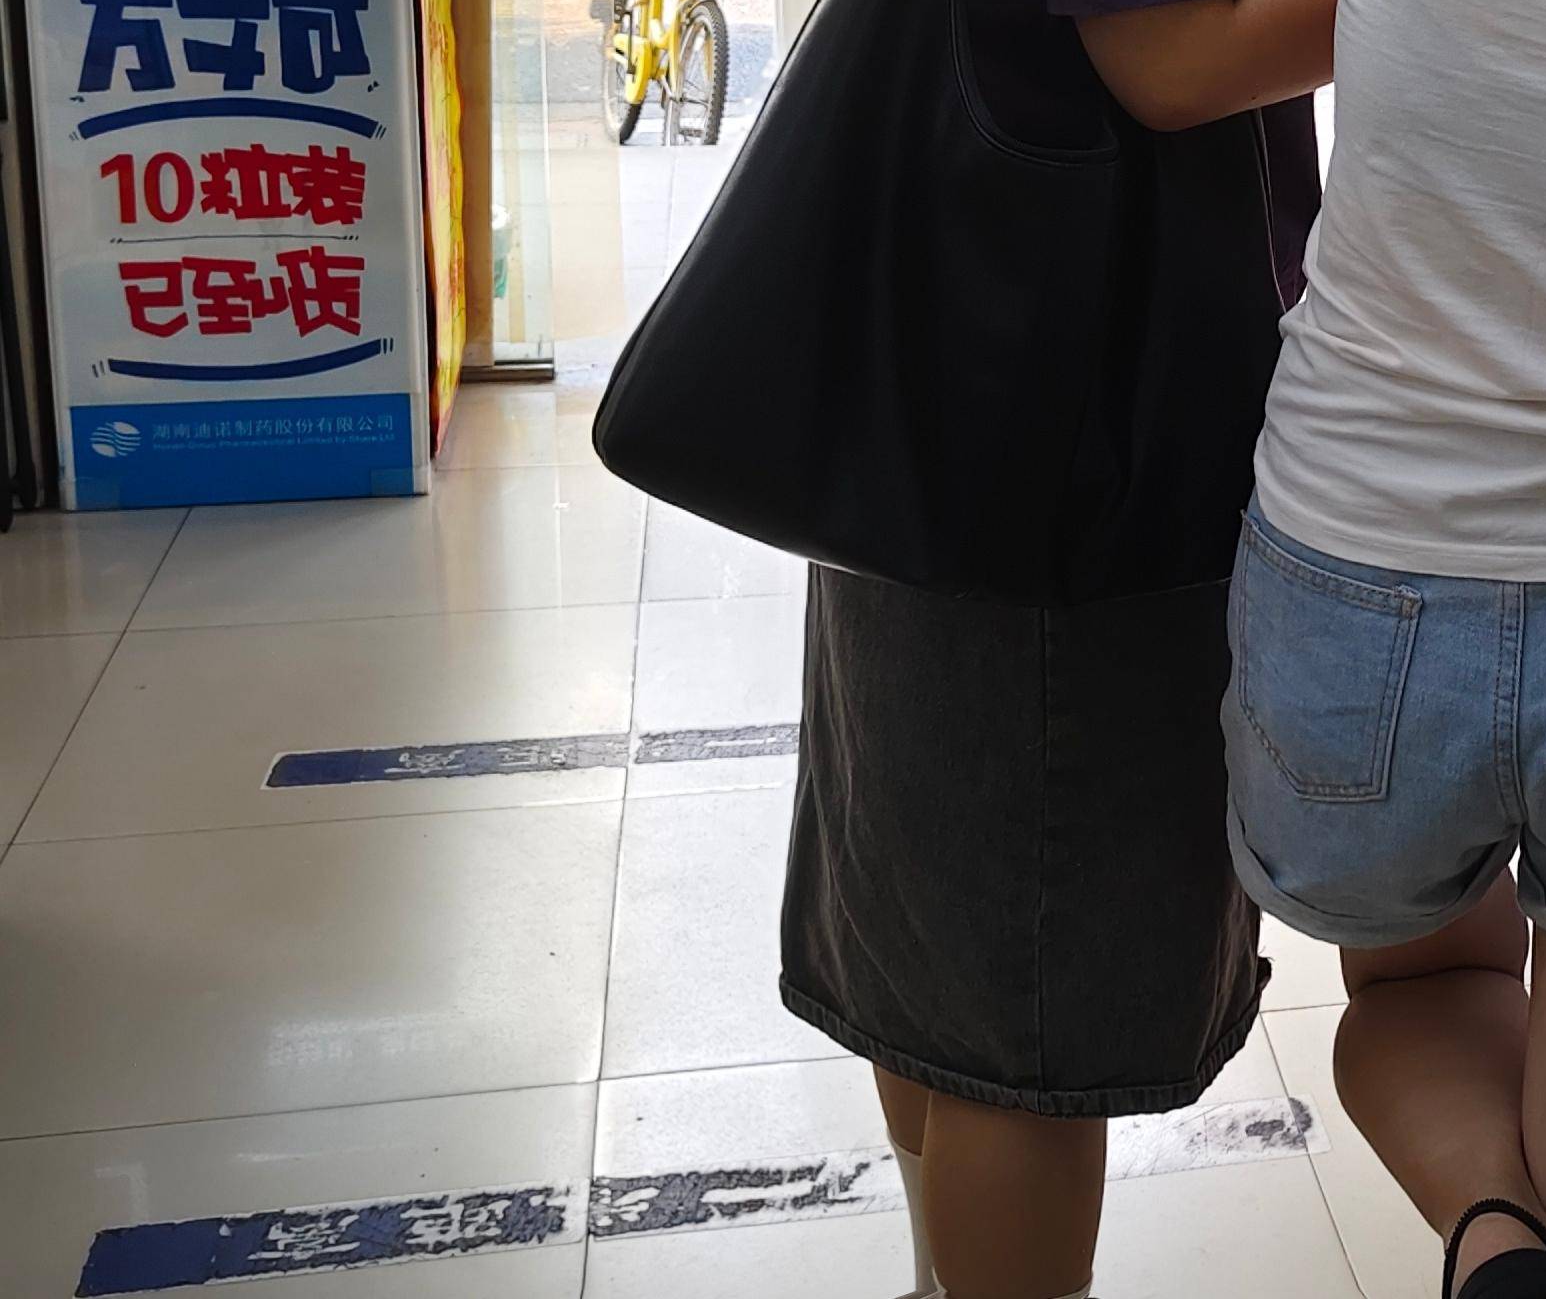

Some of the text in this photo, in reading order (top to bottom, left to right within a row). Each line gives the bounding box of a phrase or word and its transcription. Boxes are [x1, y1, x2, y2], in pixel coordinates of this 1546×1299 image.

[99, 144, 368, 227] 10粒装
[119, 246, 365, 338] 已到货
[152, 414, 395, 440] 湖南迪诺制药股份有限公司
